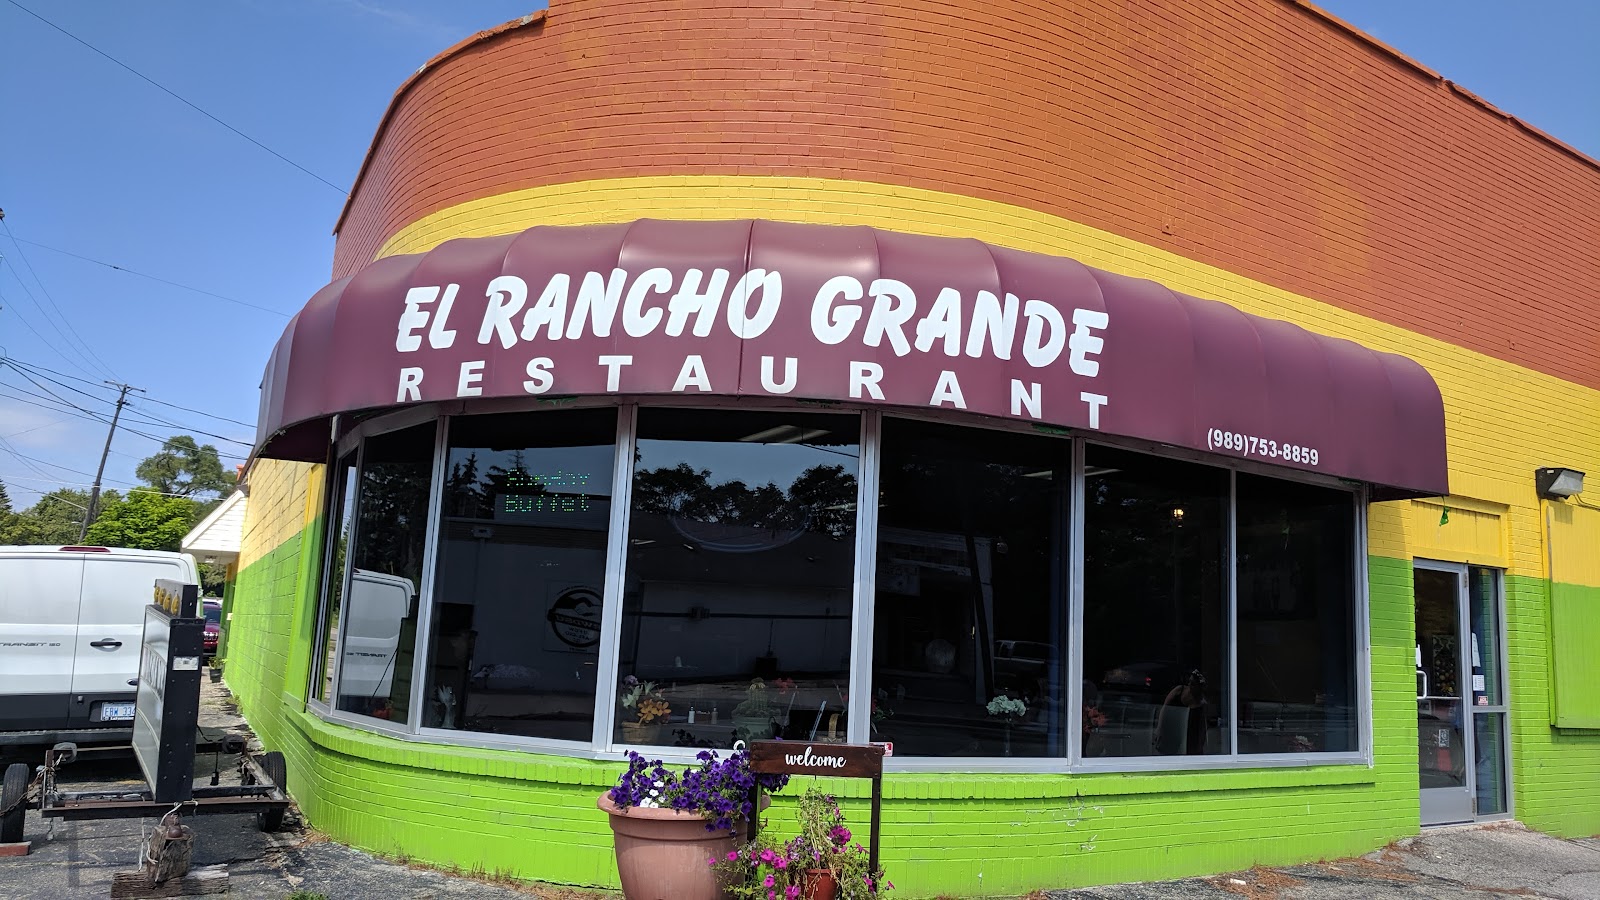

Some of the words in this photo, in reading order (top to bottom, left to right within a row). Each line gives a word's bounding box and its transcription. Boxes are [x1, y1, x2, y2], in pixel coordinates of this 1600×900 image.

[396, 283, 460, 352] EL
[477, 267, 782, 350] RANCHO
[810, 275, 1109, 377] GRANDE
[396, 354, 1108, 430] RESTAURANT
[1207, 428, 1319, 466] (989)753-8859
[785, 746, 847, 768] welcome
